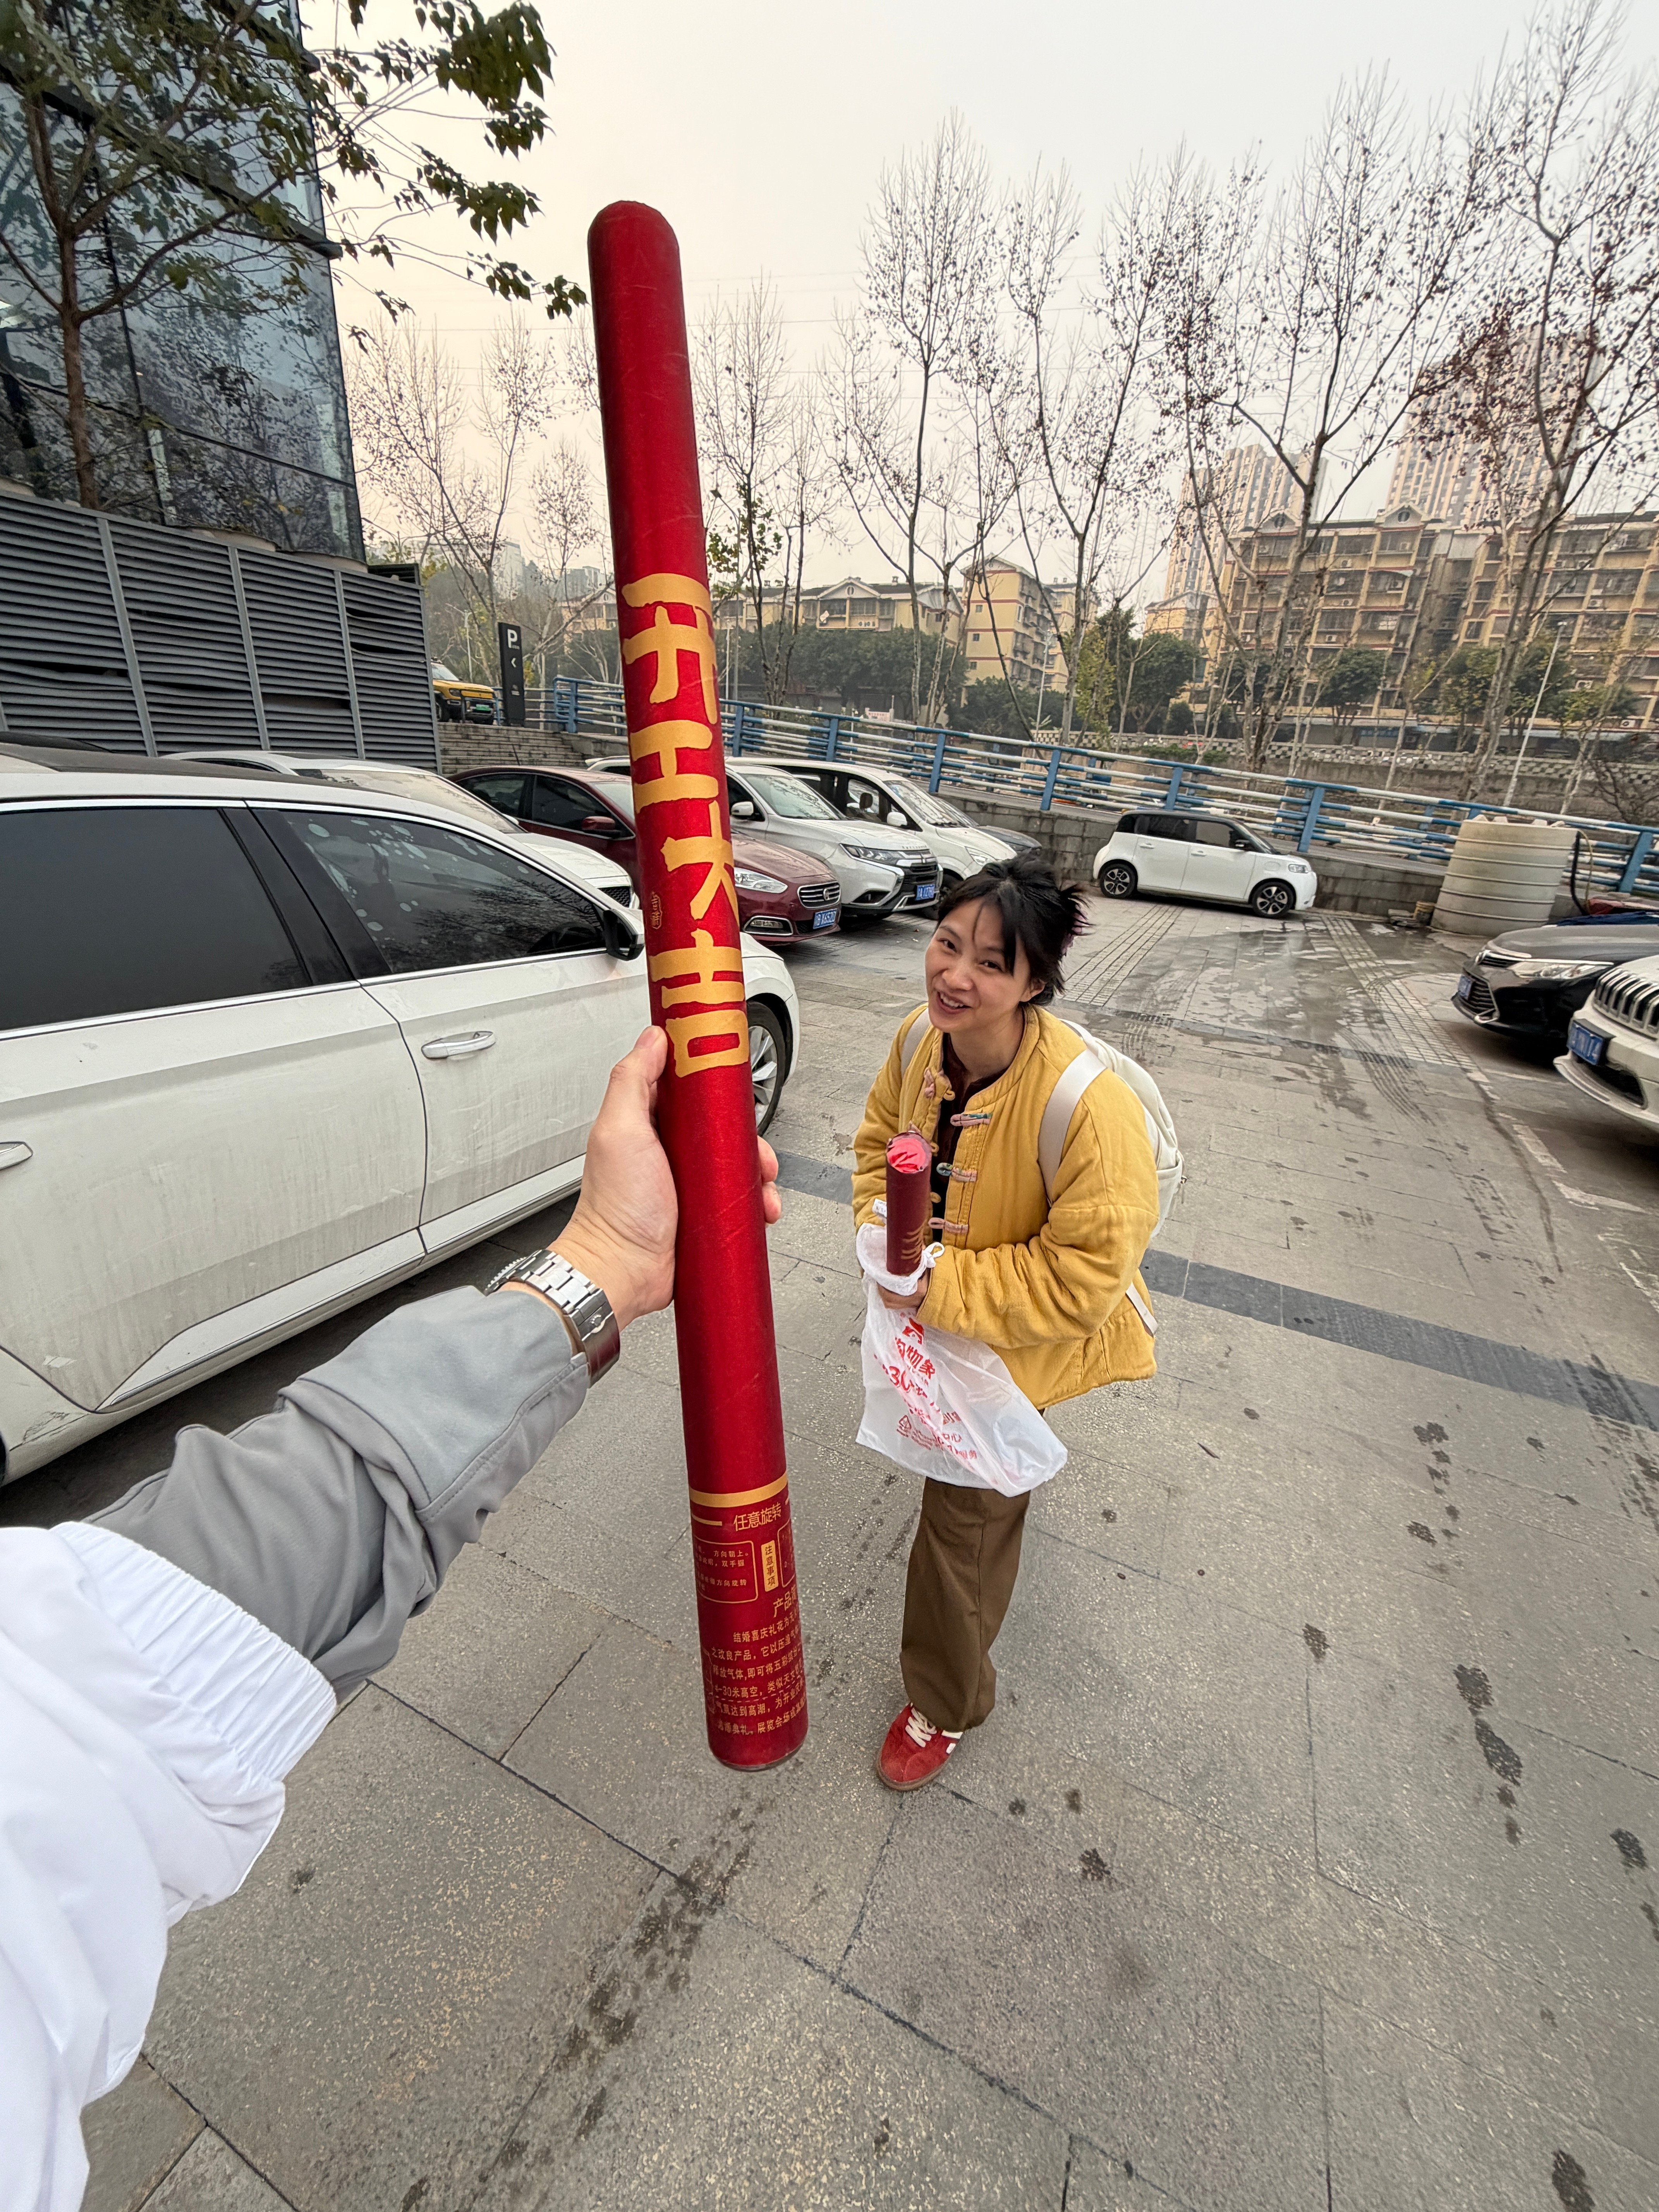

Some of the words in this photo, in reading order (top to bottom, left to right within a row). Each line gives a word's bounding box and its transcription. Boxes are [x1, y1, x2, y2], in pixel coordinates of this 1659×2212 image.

[507, 629, 518, 648] P
[621, 573, 748, 1078] 开工大吉
[733, 1502, 781, 1532] 任意旋转
[765, 1545, 776, 1585] 注意事项
